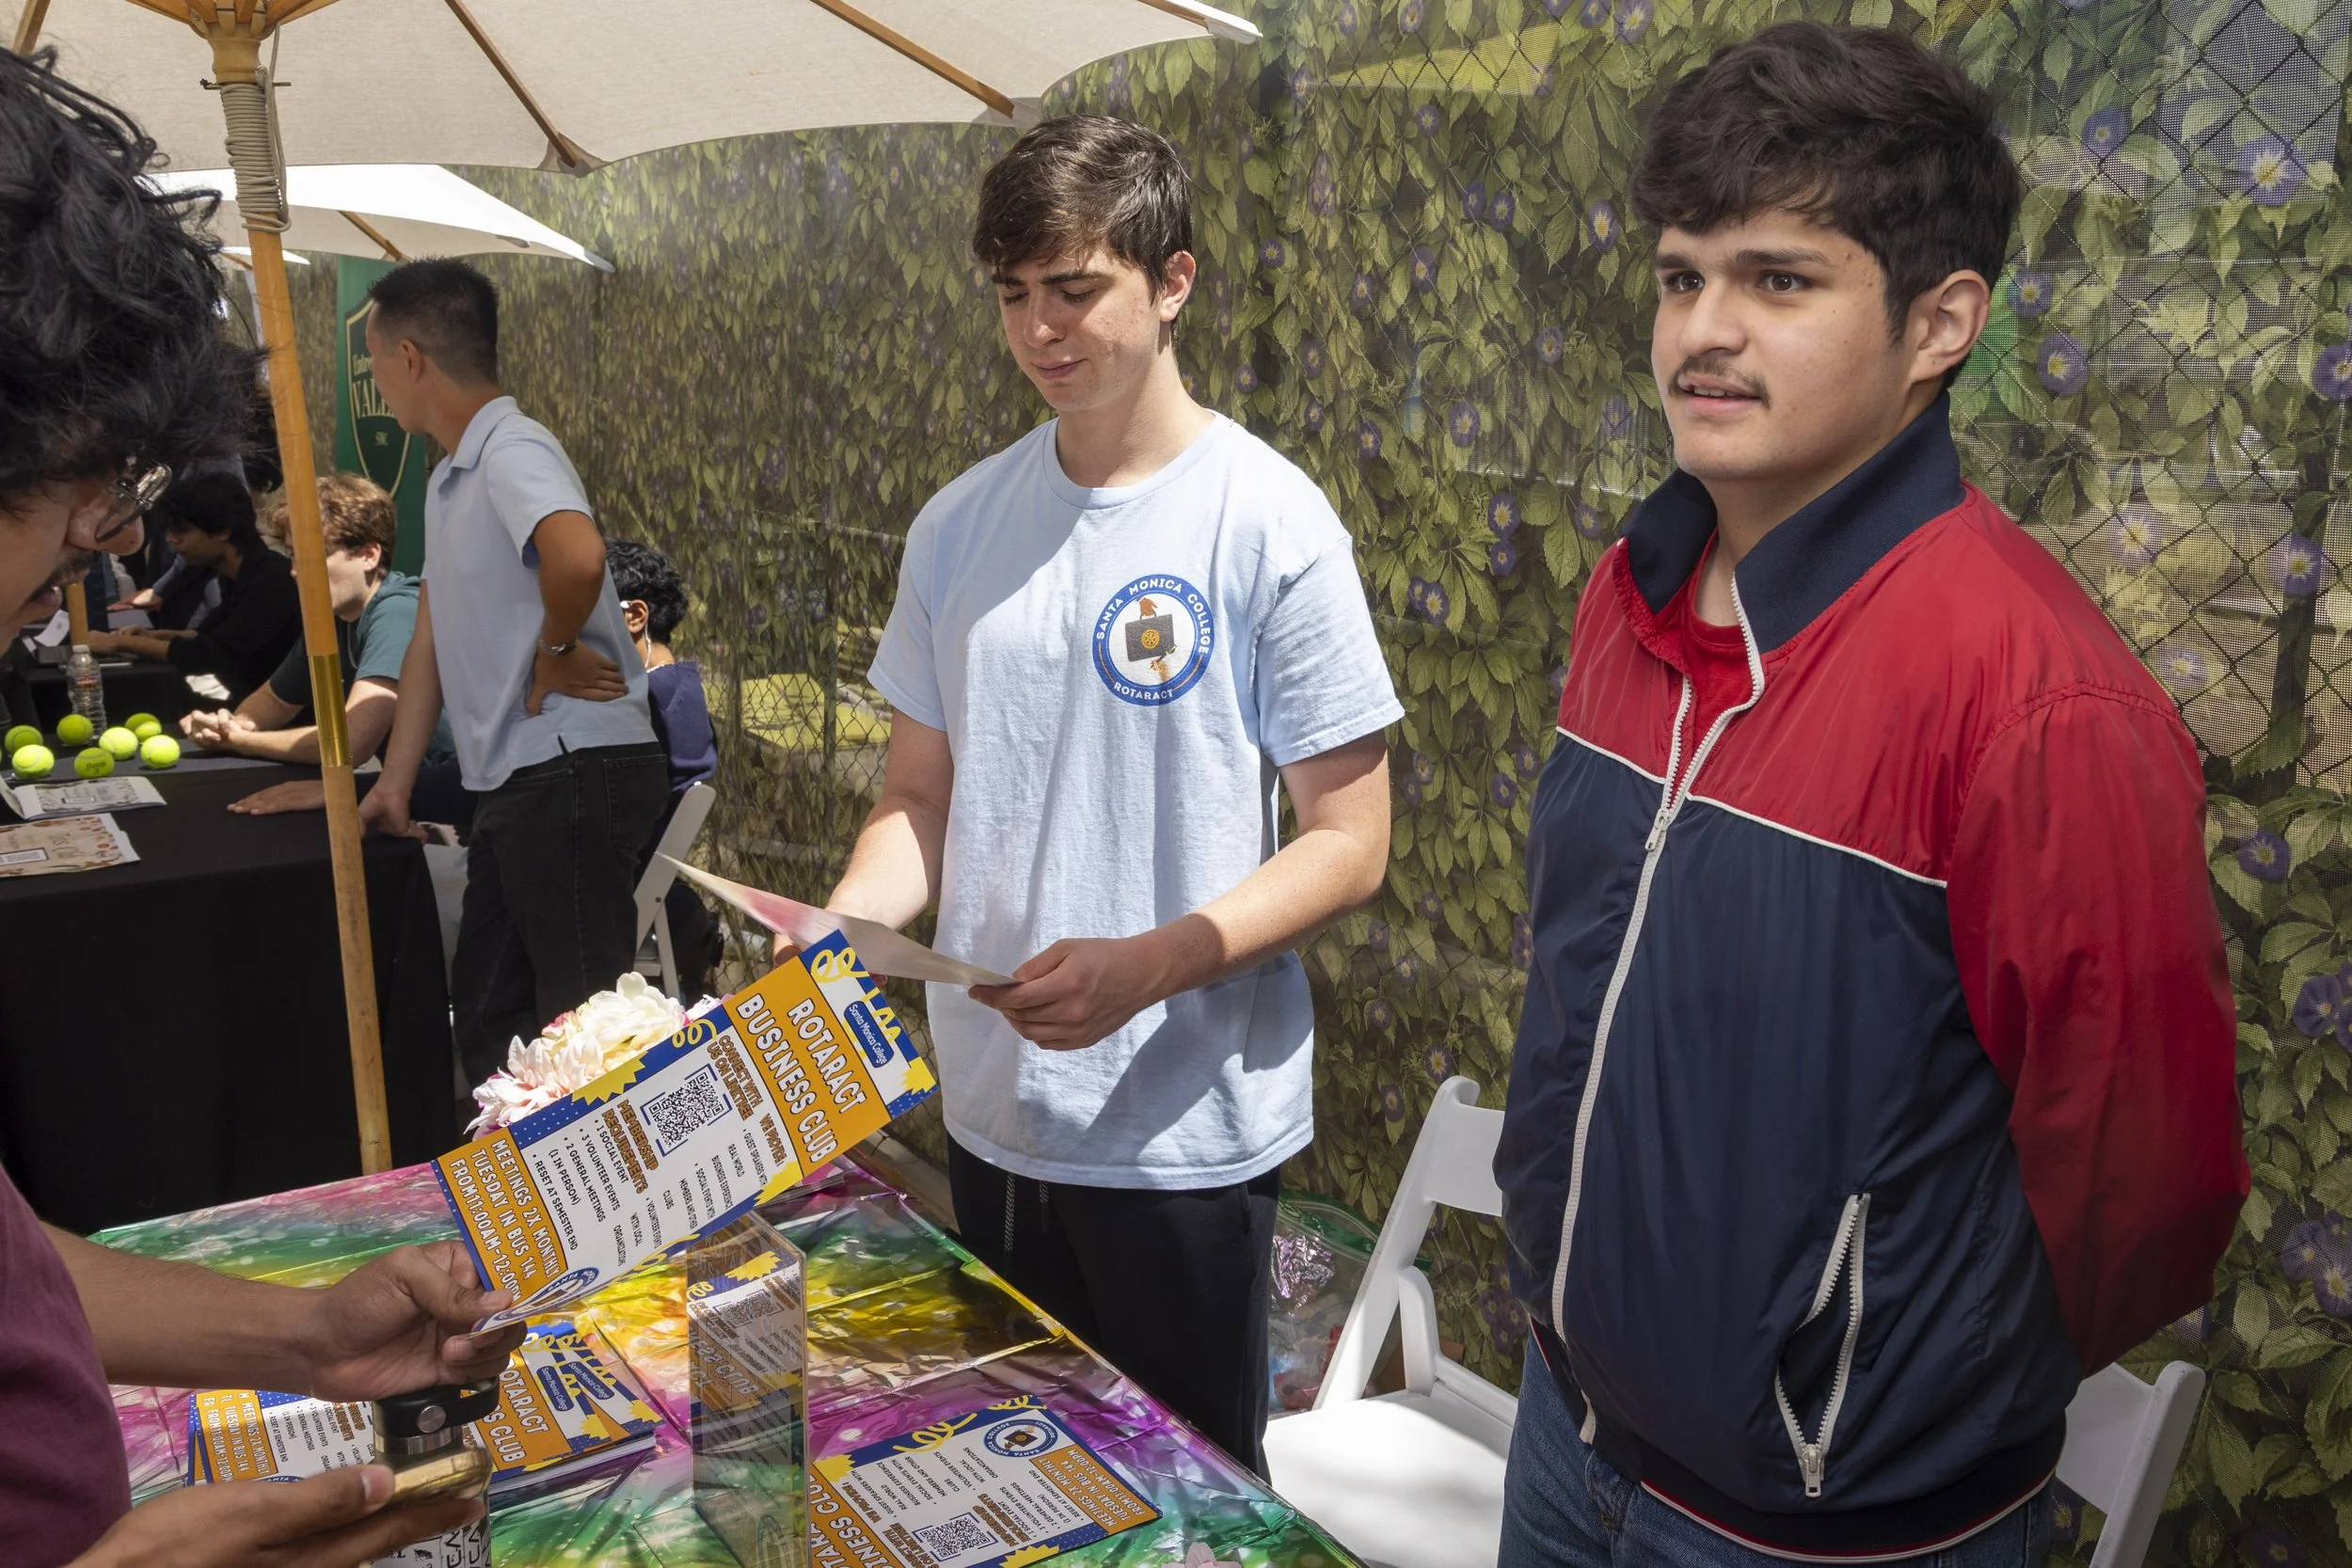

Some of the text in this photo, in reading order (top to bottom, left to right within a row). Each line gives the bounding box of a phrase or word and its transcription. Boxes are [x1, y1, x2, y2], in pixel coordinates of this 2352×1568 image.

[1097, 578, 1212, 655] SANTA MONICA COLLEGE
[1113, 682, 1174, 700] ROTARACT
[847, 1003, 889, 1067] Santa Monica College
[716, 1033, 764, 1109] CONNECT WITH
[785, 996, 867, 1115] ROTARACT
[705, 1040, 755, 1121] US ON LINKTREE
[734, 991, 841, 1164] BUSINESS CLUB
[615, 1098, 660, 1173] MEMBERSHIP
[757, 1113, 775, 1132] WE
[598, 1130, 618, 1161] SOCIAL
[612, 1159, 629, 1184] EVENT
[600, 1107, 649, 1195] REQUIREMENTS
[726, 1143, 744, 1178] REAL WORLD
[742, 1132, 768, 1187] GUEST SPEAKERS WITH
[547, 1147, 581, 1207] (1 IN PERSON)
[568, 1148, 591, 1187] GENERAL
[585, 1184, 606, 1223] MEETINGS
[583, 1140, 610, 1185] VOLUNTEER
[603, 1183, 621, 1212] EVENTS
[694, 1167, 715, 1219] SOCIAL EVENTS WITH
[710, 1154, 733, 1211] BUSINESS EXPERIENCE
[469, 1147, 537, 1281] TUESDAY IN BUS 144
[490, 1136, 562, 1279] MEETINGS 2X MONTHLY
[534, 1159, 579, 1251] RESET AT SEMESTER END
[661, 1189, 675, 1210] CLUBS
[678, 1177, 697, 1229] MEMBERS AND OTHER
[628, 1212, 644, 1246] WITH LOCAL
[645, 1200, 661, 1249] VOLUNTEER EVENTS
[612, 1224, 627, 1267] ORGANIZATIONS
[548, 1273, 579, 1291] SANTA
[496, 1360, 551, 1433] OTARACT
[539, 1367, 569, 1411] Santa Monica College
[567, 1362, 610, 1400] Santa Monica College
[222, 1404, 241, 1435] TUESDAY
[240, 1402, 261, 1436] MEETINGS
[267, 1415, 279, 1429] RESET
[283, 1421, 297, 1439] PERSON)
[296, 1413, 315, 1450] GENERAL MEETINGS
[310, 1409, 325, 1433] VOLUNTEER
[323, 1406, 339, 1433] SOCIAL EVENT
[230, 1436, 244, 1446] IN
[232, 1445, 246, 1459] BUS
[249, 1436, 262, 1446] 2X
[272, 1433, 287, 1454] SEMESTER
[278, 1453, 289, 1463] END
[317, 1432, 329, 1447] EVENTS
[335, 1450, 345, 1462] WITH
[485, 1424, 529, 1463] CLUB
[235, 1459, 249, 1472] 144
[251, 1446, 271, 1475] MONTHLY
[889, 1458, 933, 1500] SOCIAL EVENTS WITH
[903, 1455, 947, 1497] MEMBERS AND OTHER
[932, 1450, 974, 1488] VOLUNTEER EVENTS
[958, 1459, 986, 1483] WITH LOCAL
[961, 1446, 999, 1479] ORGANIZATIONS
[1026, 1468, 1041, 1479] END
[807, 1473, 842, 1516] CLU
[849, 1469, 895, 1514] GUEST SPEAKERS WITH
[875, 1461, 921, 1506] BUSINESS EXPERIENCE
[880, 1483, 908, 1510] REAL WORLD
[943, 1478, 961, 1492] CLUBS
[998, 1485, 1019, 1502] EVENTS
[1009, 1481, 1035, 1503] MEETINGS
[1035, 1456, 1118, 1527] MEETINGS 2X MONTHLY
[1036, 1478, 1061, 1499] SEMESTER
[1058, 1459, 1132, 1521] TUESDAY IN BUS 144
[864, 1509, 882, 1523] WE
[976, 1492, 1032, 1543] REQUIREMENTS
[996, 1499, 1031, 1531] SOCIAL EVENT
[1013, 1501, 1043, 1527] VOLUNTEER
[1030, 1502, 1055, 1523] GENERAL
[1036, 1493, 1060, 1513] PERSON)
[1063, 1503, 1081, 1517] RESET
[882, 1528, 905, 1547] WITH
[888, 1522, 935, 1565] ON LINKTREE
[970, 1503, 1019, 1547] MEMBERSHIP
